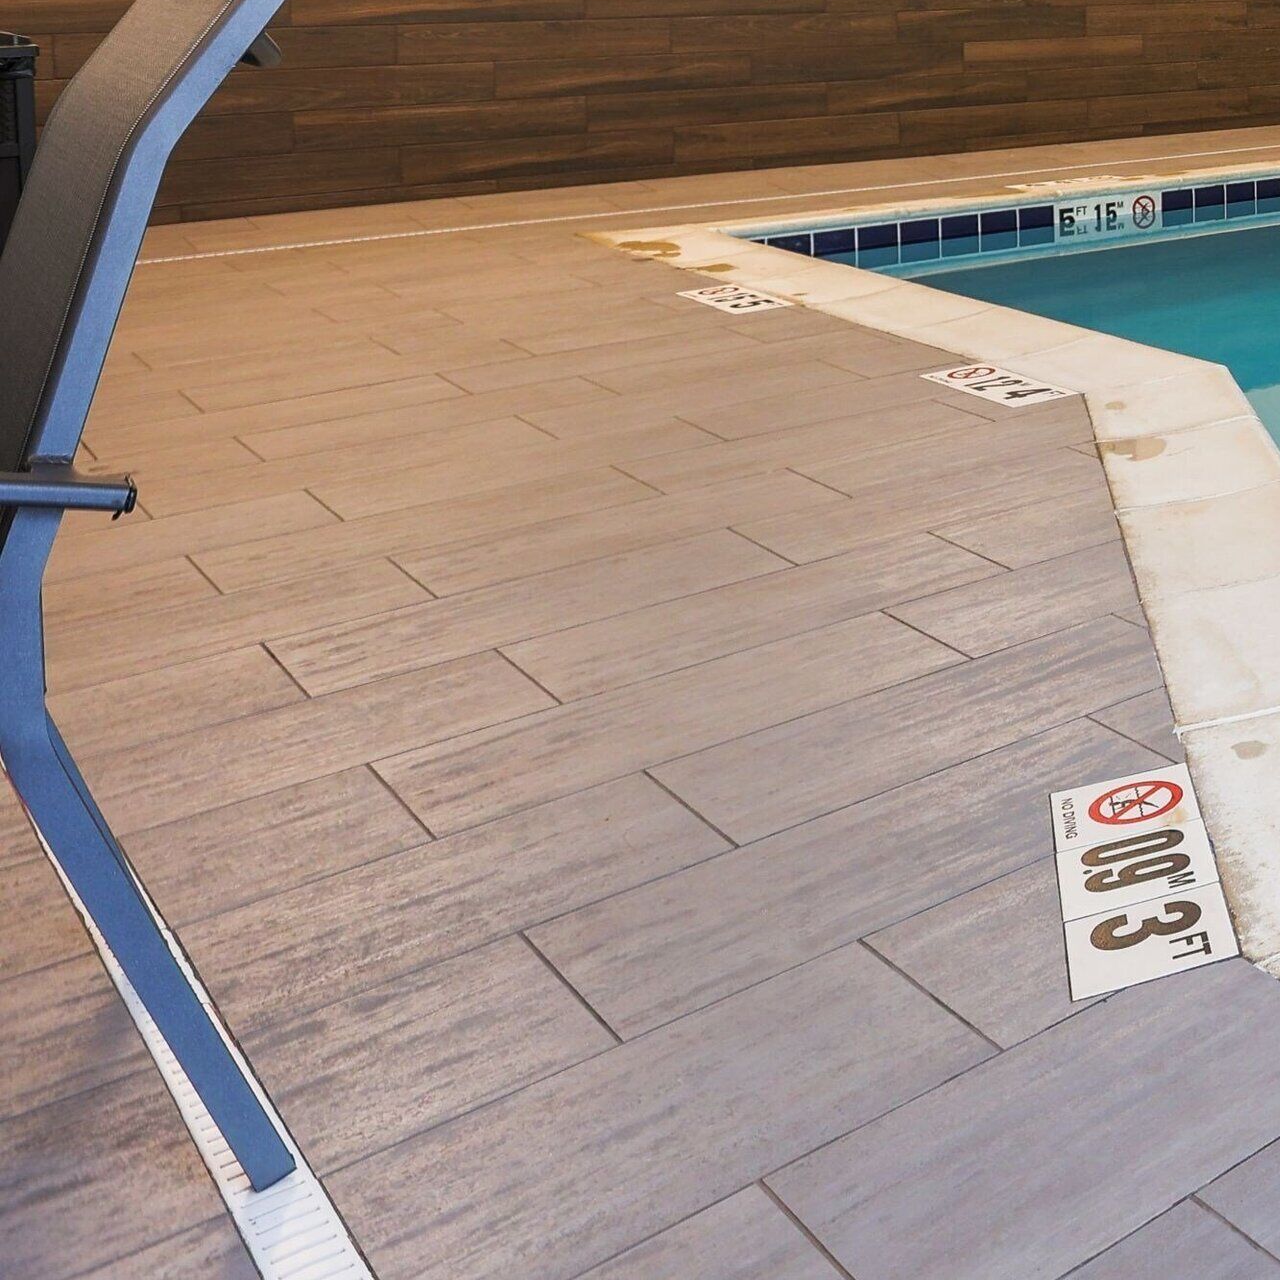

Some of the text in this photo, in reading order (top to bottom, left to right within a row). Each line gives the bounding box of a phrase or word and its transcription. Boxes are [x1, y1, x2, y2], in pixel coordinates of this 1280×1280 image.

[1076, 205, 1088, 216] FT
[1117, 201, 1124, 209] M
[1061, 798, 1078, 840] NO DIVING
[1167, 870, 1196, 889] M
[1089, 900, 1202, 951] 3
[1168, 930, 1213, 960] FT
